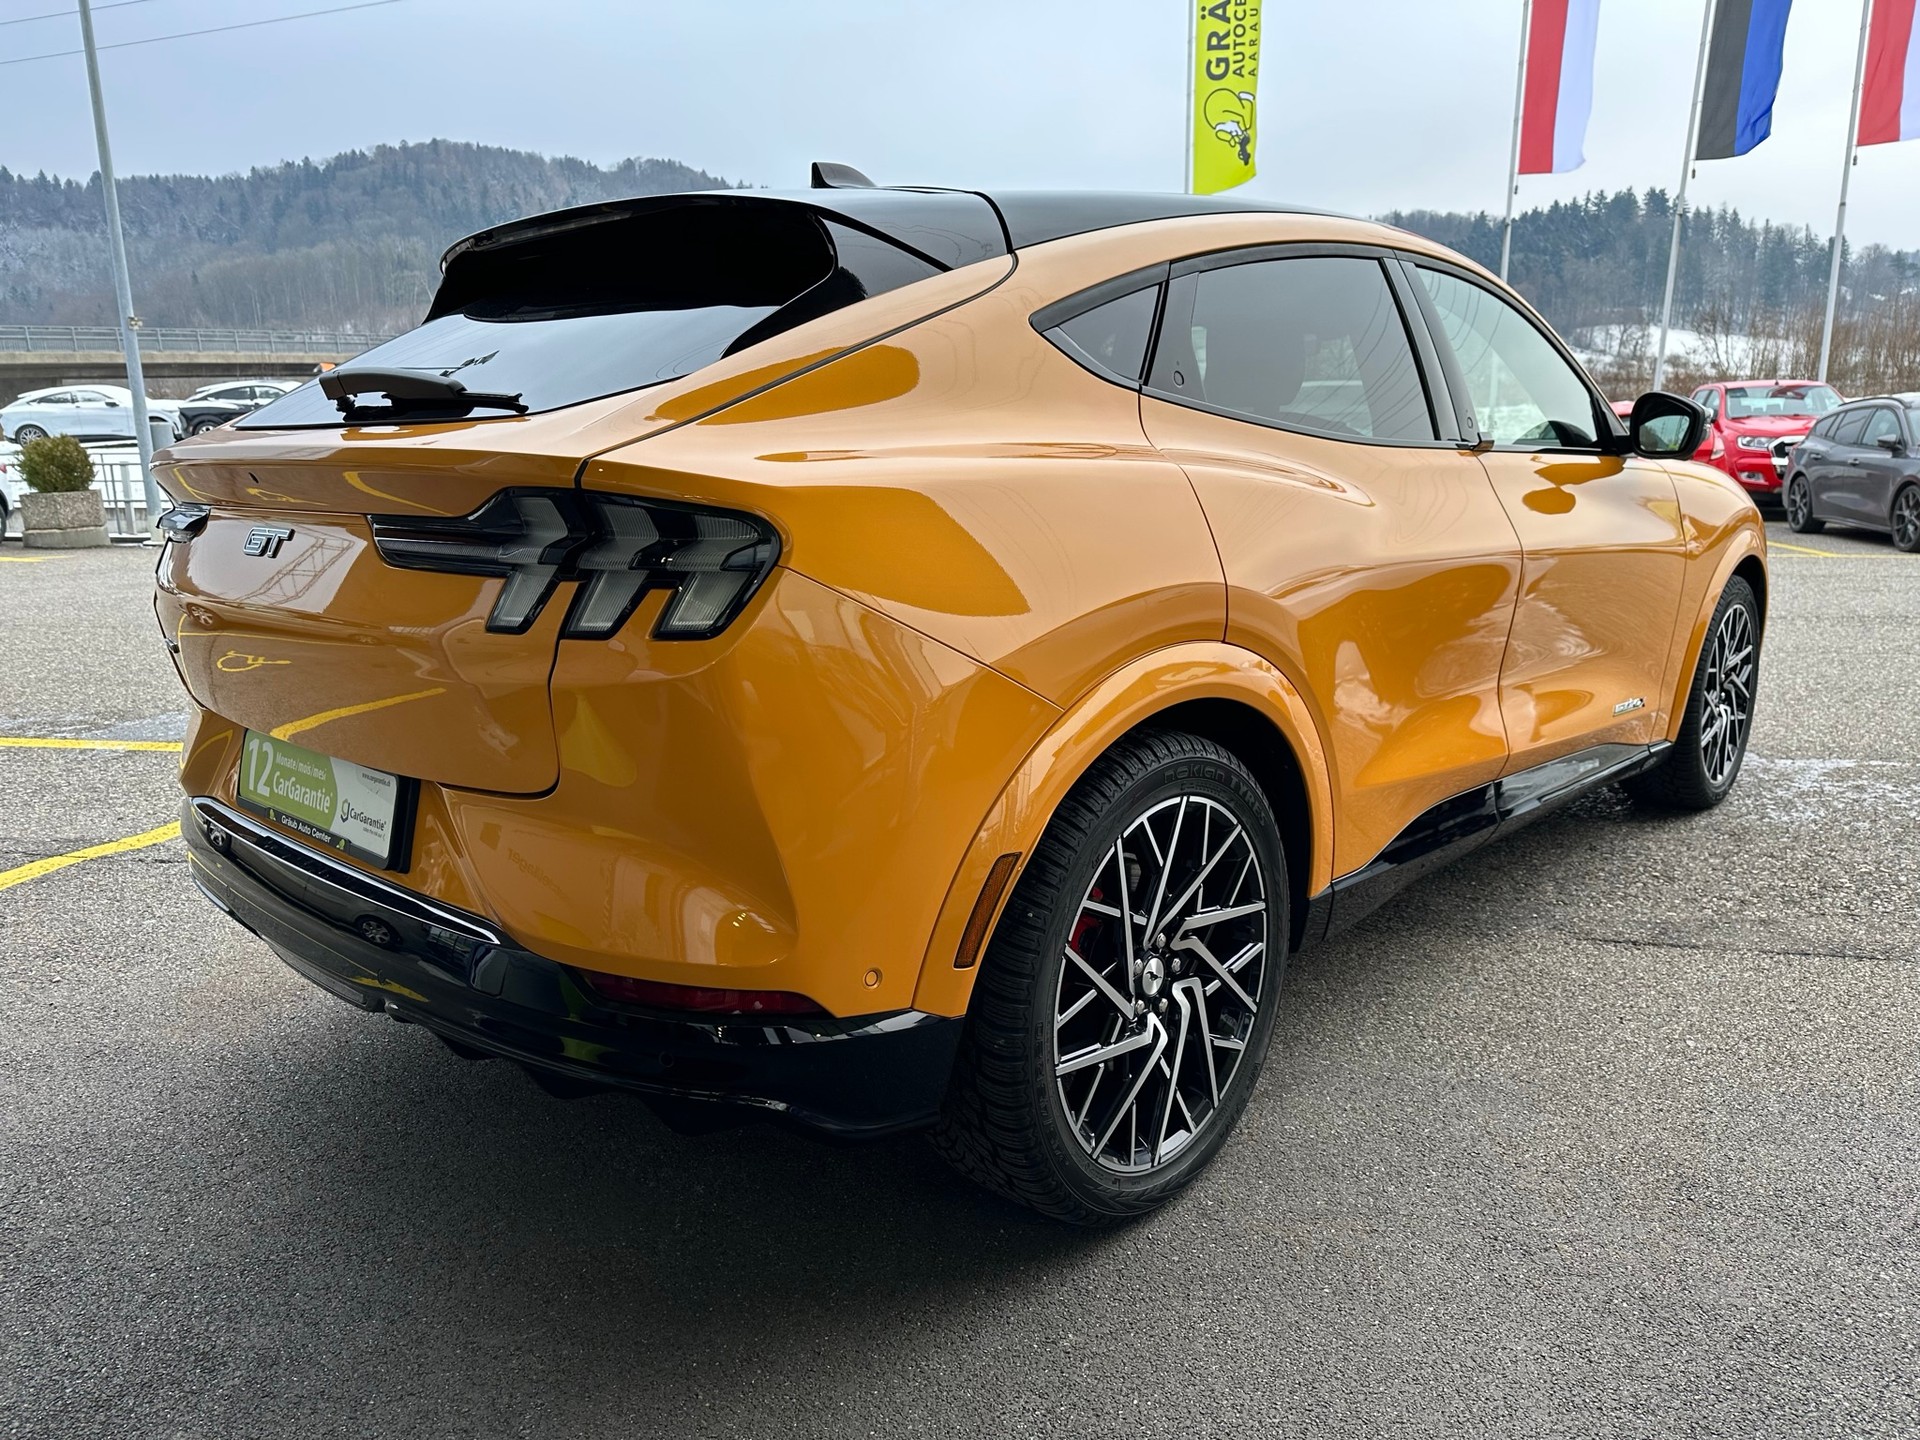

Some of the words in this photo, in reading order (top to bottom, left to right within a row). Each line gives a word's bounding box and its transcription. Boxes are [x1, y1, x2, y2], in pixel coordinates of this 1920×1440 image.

[1248, 8, 1259, 77] AARAU
[243, 526, 296, 559] GT
[248, 738, 274, 798] 12
[1230, 775, 1266, 827] TYRES
[281, 815, 298, 831] Gräub
[298, 822, 312, 836] Auto
[312, 828, 331, 844] Center
